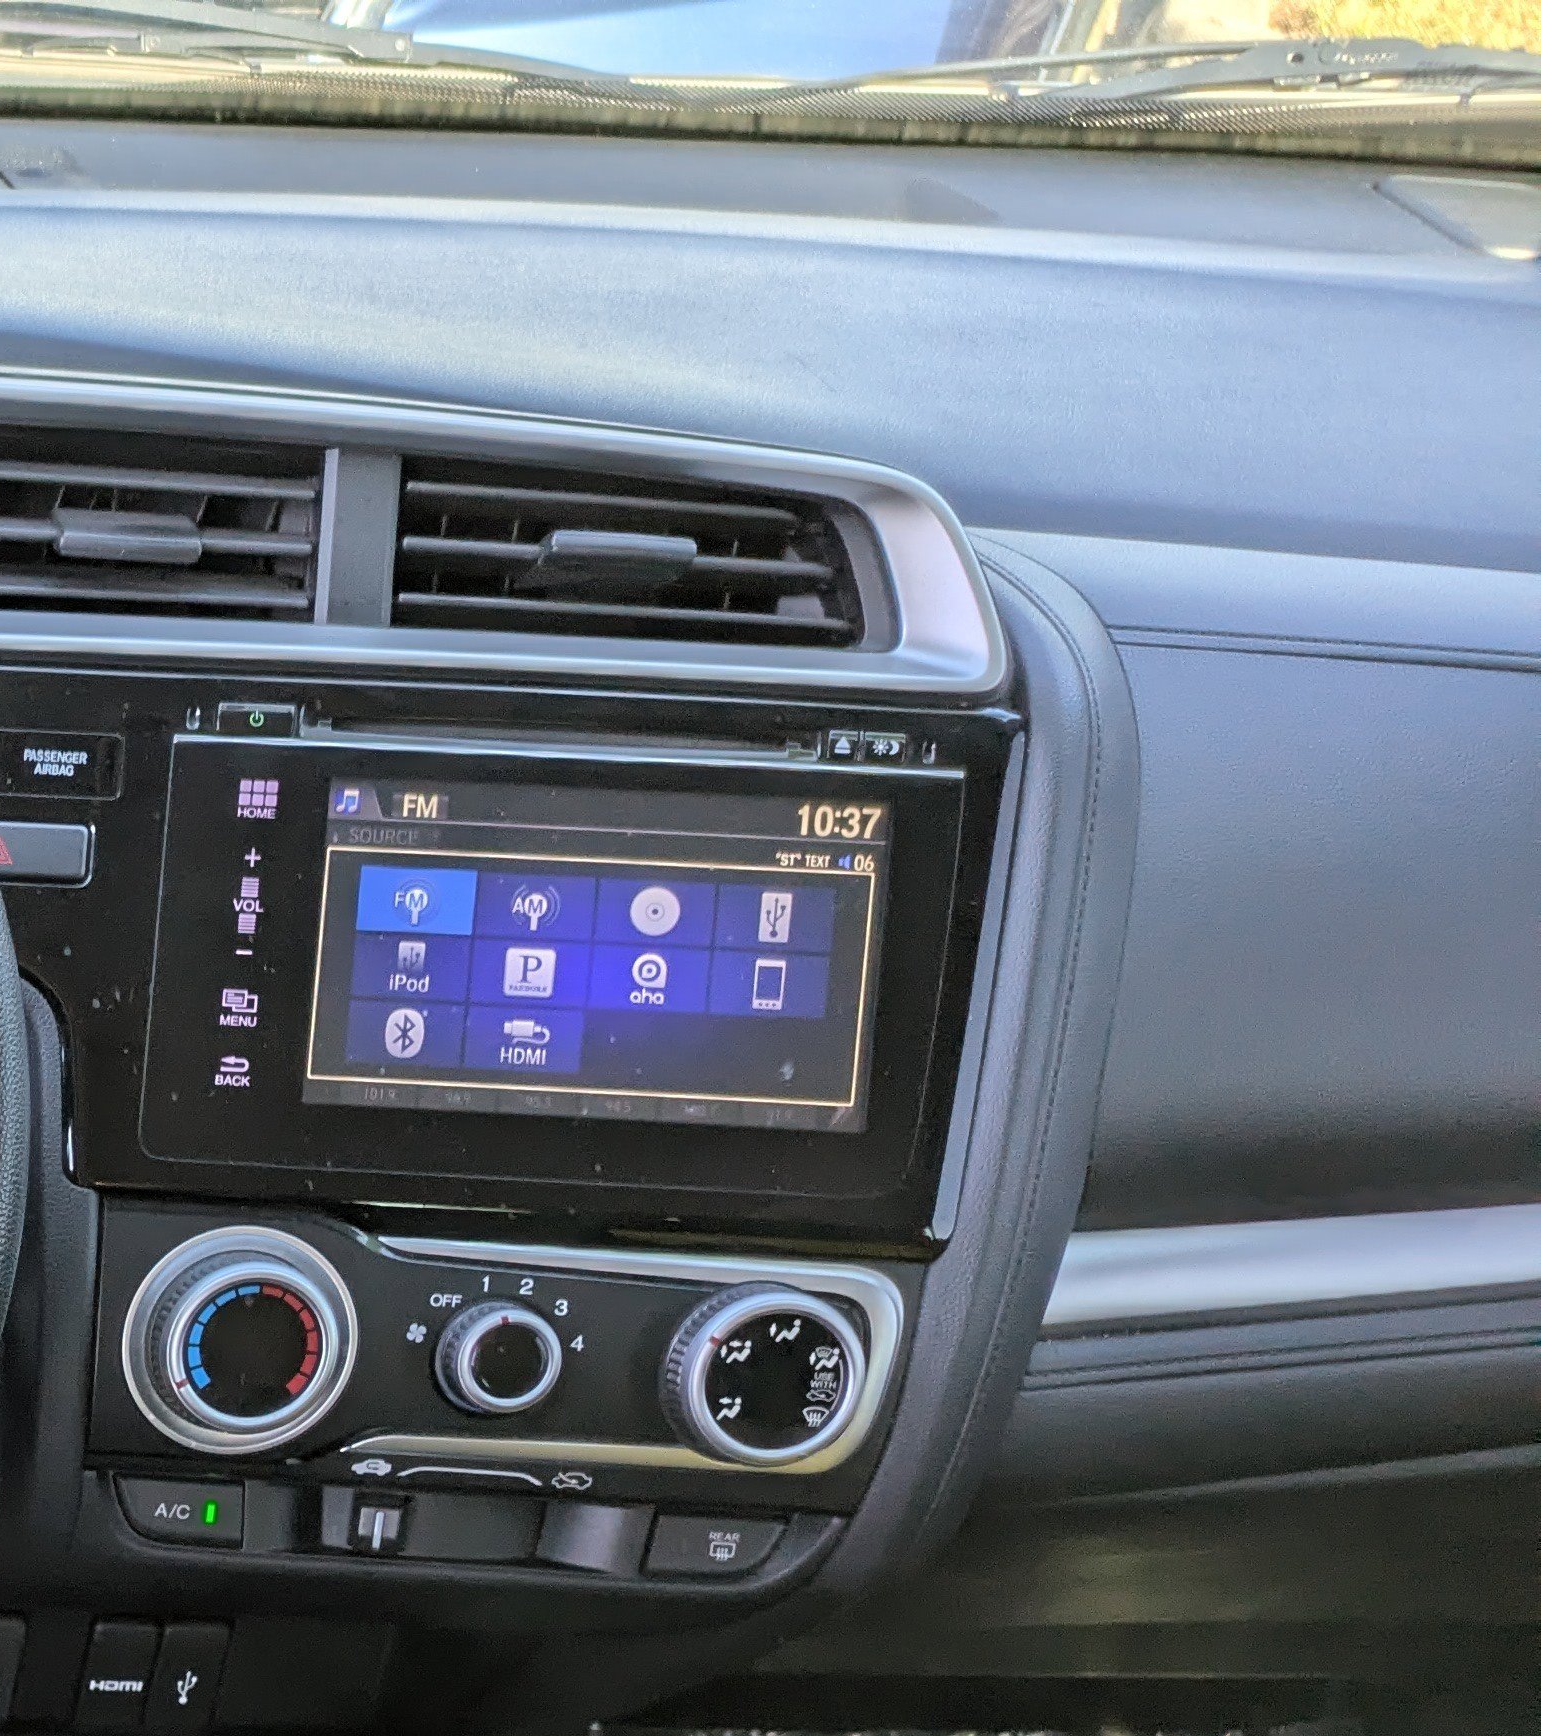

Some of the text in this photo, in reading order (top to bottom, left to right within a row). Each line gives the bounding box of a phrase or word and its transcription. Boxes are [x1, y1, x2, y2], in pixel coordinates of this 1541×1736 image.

[23, 748, 88, 765] PASSENGER
[33, 763, 75, 777] AIRBAG
[237, 806, 276, 819] HOME
[403, 794, 439, 818] FM
[798, 804, 882, 839] 10:37
[805, 855, 831, 868] TEXT
[854, 854, 875, 872] 06
[233, 899, 264, 913] VOL
[394, 890, 428, 909] FM
[512, 897, 546, 914] AM
[519, 954, 543, 983] P
[390, 974, 430, 993] iPod
[630, 988, 664, 1005] aha
[219, 1014, 257, 1028] MENU
[500, 1047, 547, 1066] HDMI
[214, 1074, 250, 1087] BACK
[482, 1274, 491, 1293] 1
[519, 1278, 534, 1296] 2
[429, 1293, 463, 1308] OFF
[554, 1300, 568, 1316] 3
[570, 1334, 584, 1352] 4
[154, 1503, 191, 1520] A/C
[89, 1680, 143, 1692] HDMI
